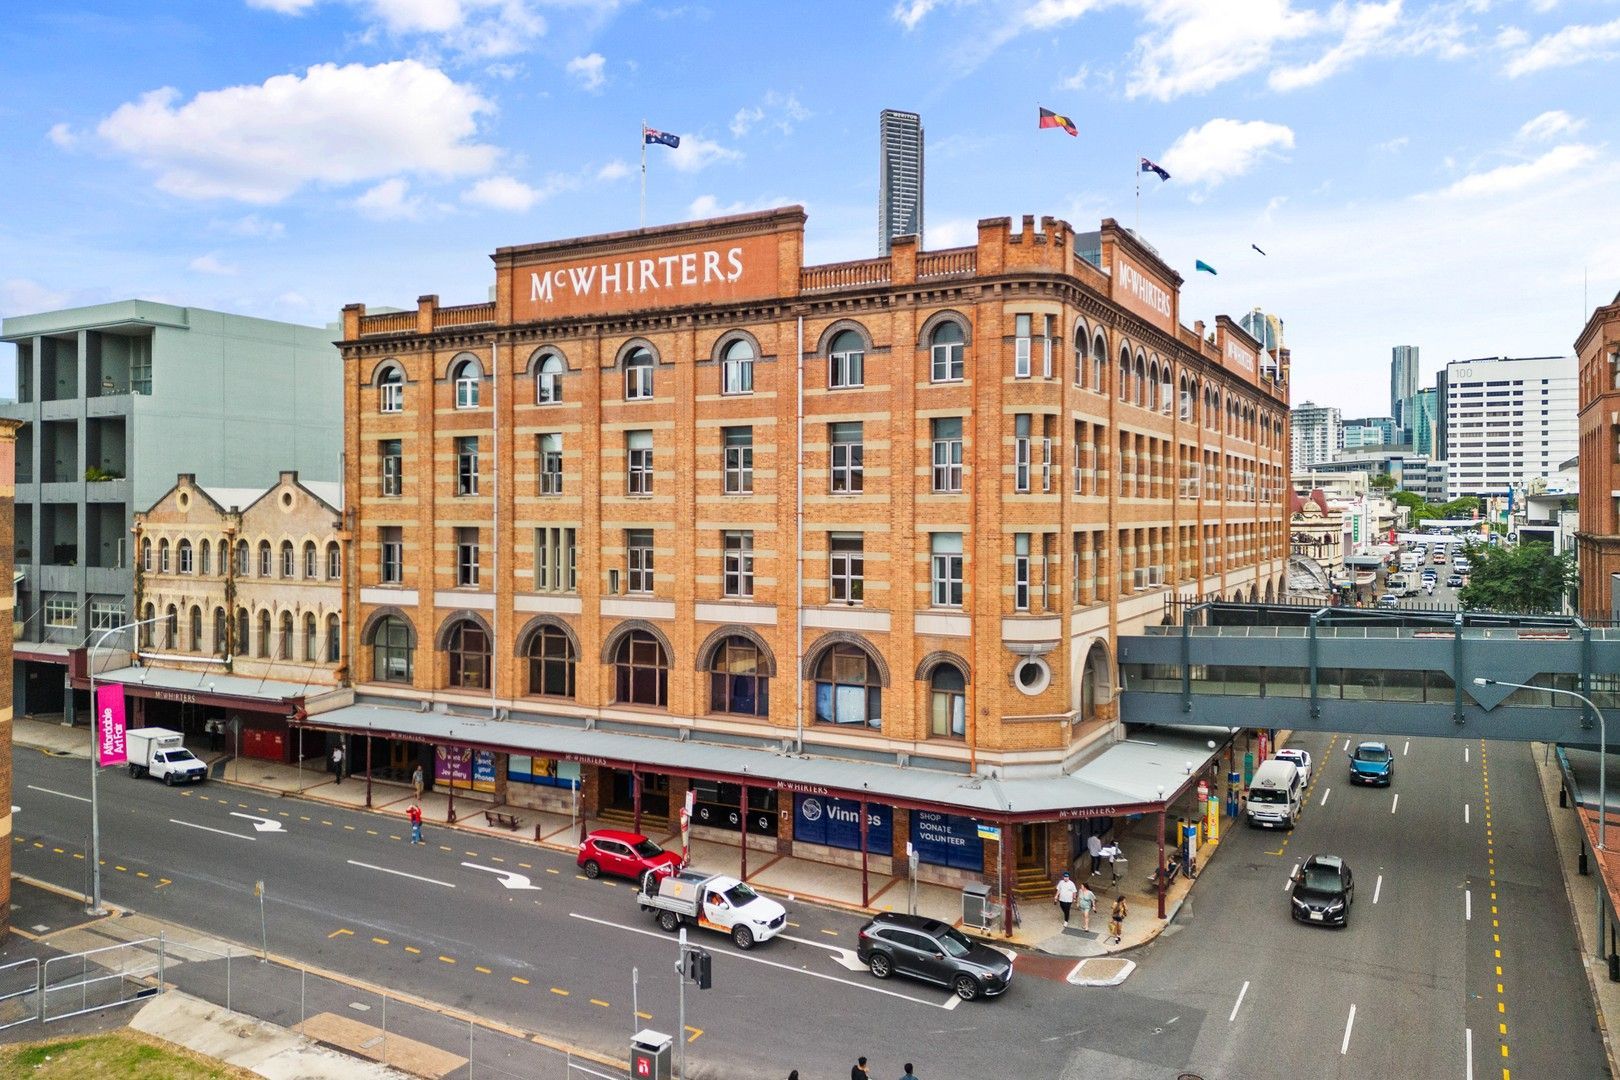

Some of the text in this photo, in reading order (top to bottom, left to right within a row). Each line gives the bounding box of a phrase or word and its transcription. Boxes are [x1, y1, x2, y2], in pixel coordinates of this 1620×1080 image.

[530, 247, 744, 302] McWHIRTERS
[1455, 368, 1473, 378] 100
[102, 707, 114, 756] Affordable
[113, 723, 124, 754] Art Fair
[441, 768, 467, 780] Jewllery
[826, 804, 882, 826] Vinnes
[919, 812, 941, 821] SHOP
[919, 822, 952, 834] DONATE
[919, 832, 966, 846] VOLUNTEER
